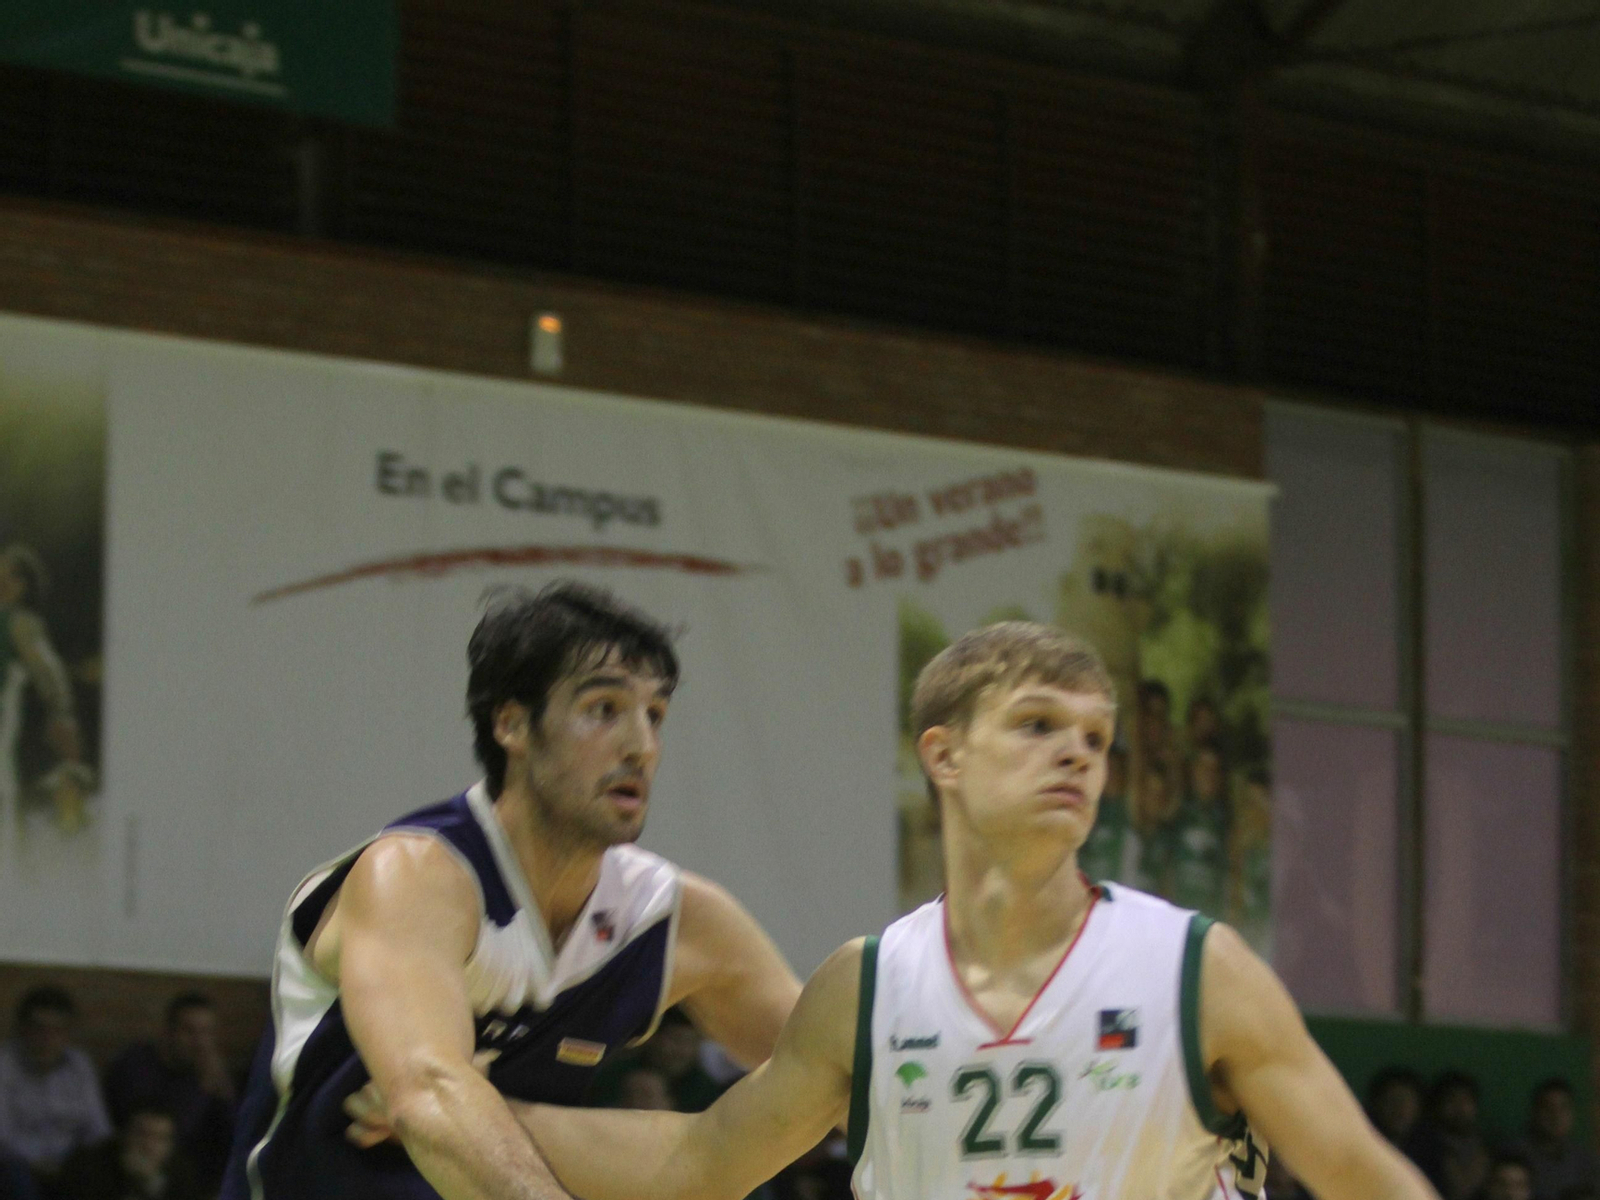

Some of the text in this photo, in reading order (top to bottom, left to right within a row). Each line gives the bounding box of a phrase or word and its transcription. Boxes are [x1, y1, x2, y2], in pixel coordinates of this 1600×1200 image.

[375, 450, 662, 533] En el Campus
[949, 1059, 1066, 1161] 22
